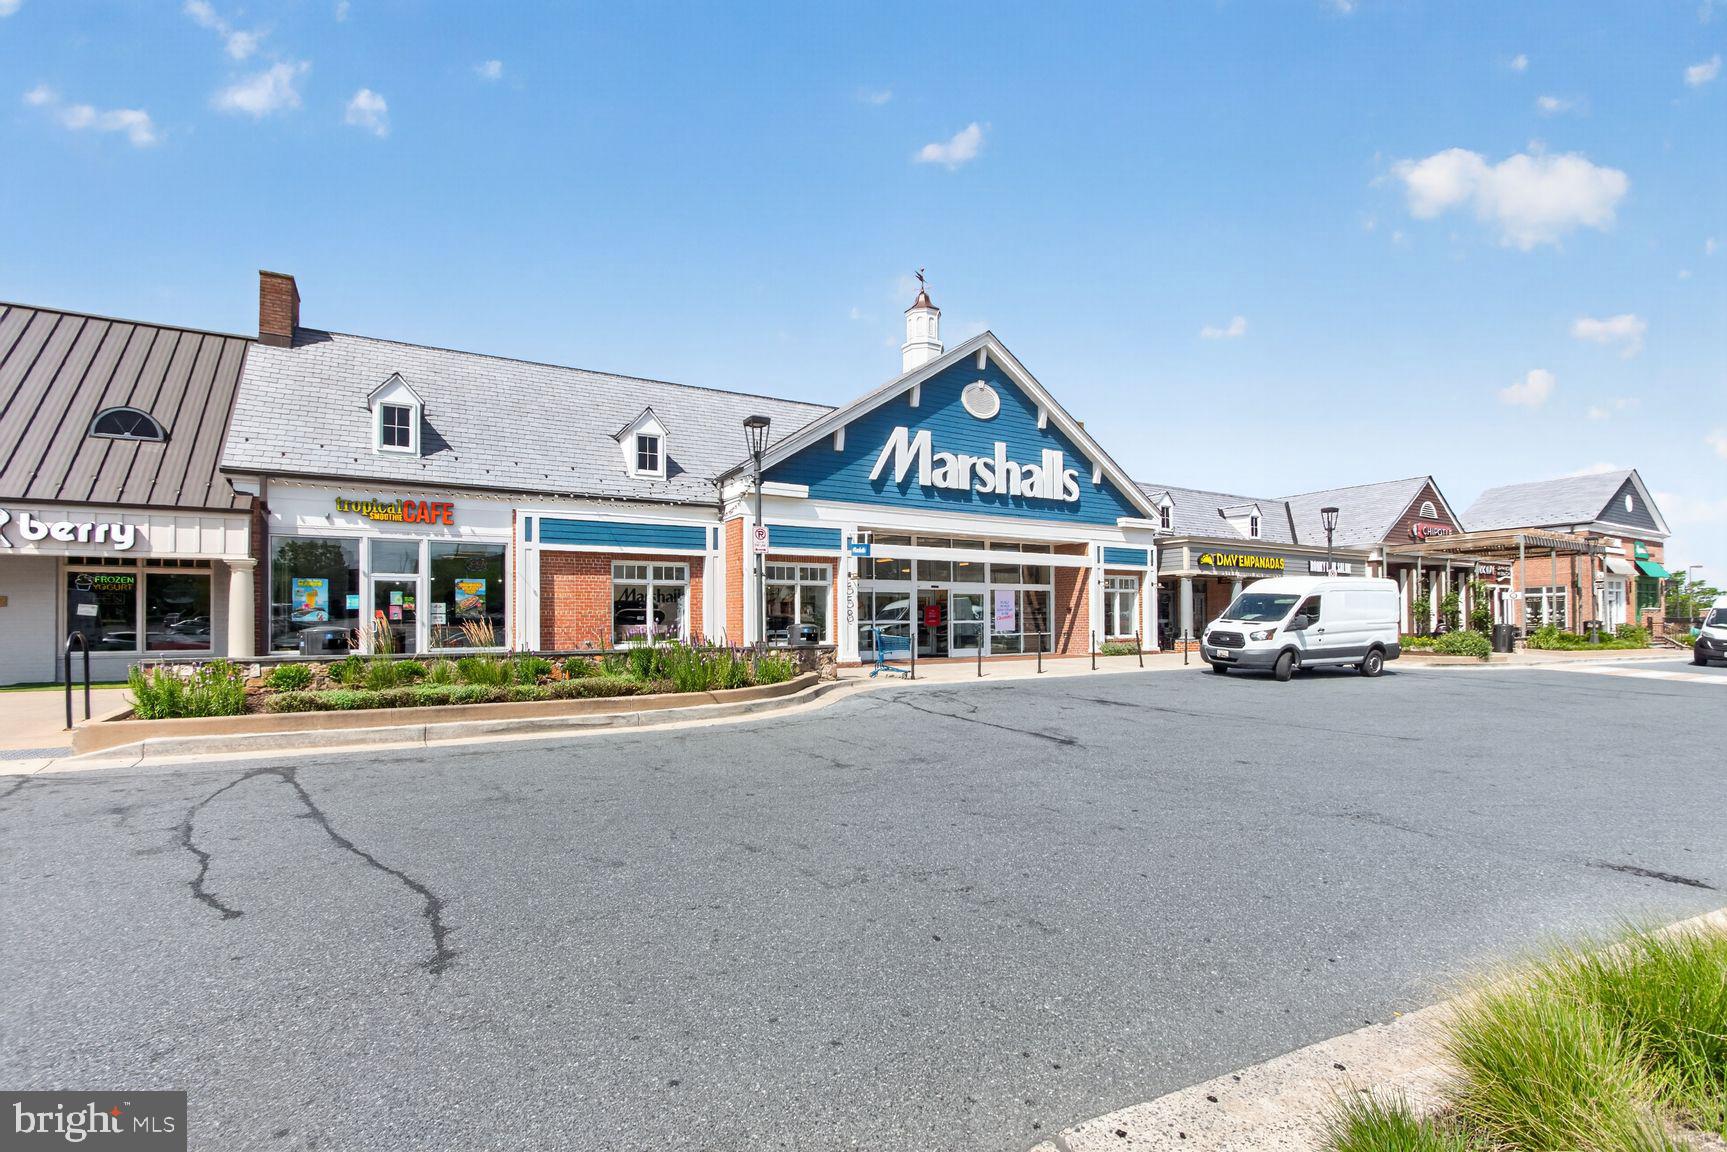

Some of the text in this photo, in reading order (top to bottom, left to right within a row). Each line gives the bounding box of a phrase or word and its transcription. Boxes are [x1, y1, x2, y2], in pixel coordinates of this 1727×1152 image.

[869, 427, 1080, 502] Marshalls
[335, 496, 403, 516] tropical
[403, 500, 455, 525] CAFE
[19, 512, 136, 550] berry
[1216, 553, 1285, 570] DMV EMPANADAS
[92, 583, 133, 591] YOGURT
[94, 575, 135, 584] FROZEN
